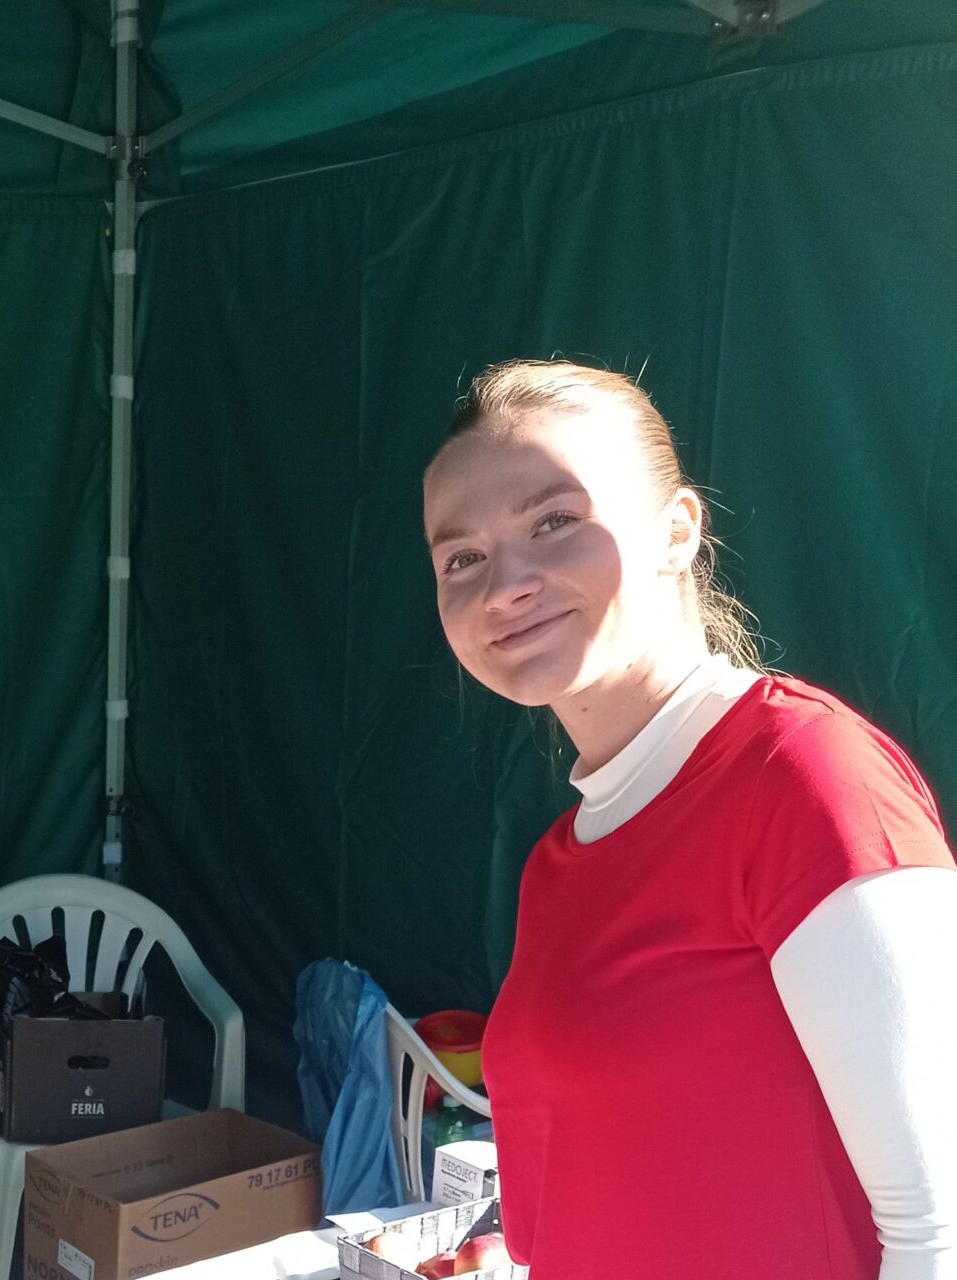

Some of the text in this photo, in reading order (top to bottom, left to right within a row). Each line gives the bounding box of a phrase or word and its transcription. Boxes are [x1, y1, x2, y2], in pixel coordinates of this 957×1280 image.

[71, 1103, 105, 1115] FERIA
[247, 1173, 263, 1189] 79
[267, 1167, 282, 1184] 17
[285, 1163, 300, 1179] 61
[149, 1205, 200, 1232] TENA
